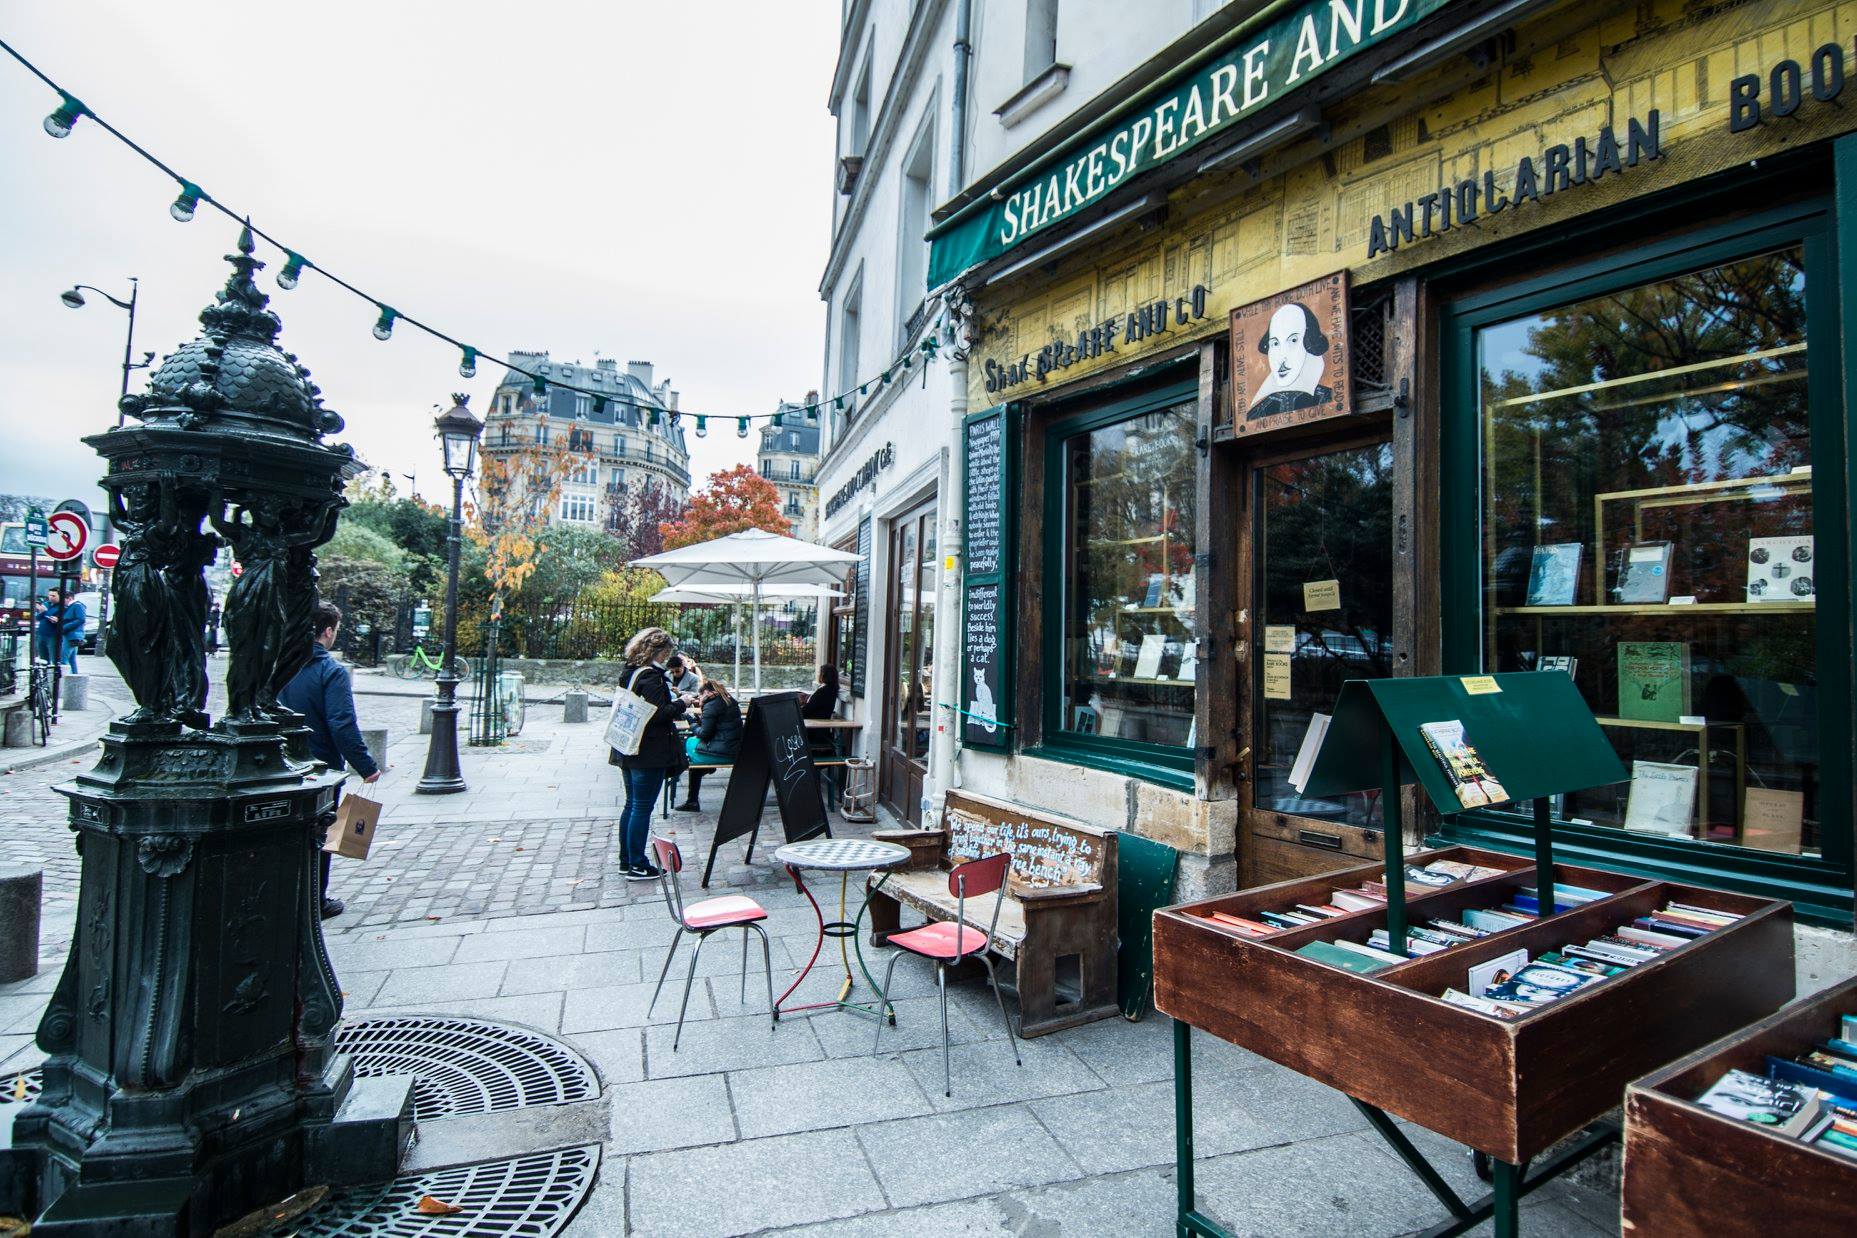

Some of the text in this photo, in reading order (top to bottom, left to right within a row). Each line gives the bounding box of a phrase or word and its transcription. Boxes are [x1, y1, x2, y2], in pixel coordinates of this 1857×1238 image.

[1730, 36, 1857, 134] BOO
[1000, 0, 1408, 247] SHAKESPEARE AND
[1124, 299, 1169, 346] AND
[973, 599, 997, 613] worldly
[967, 621, 997, 633] Beside him
[978, 634, 984, 644] a
[970, 654, 975, 663] a
[1052, 827, 1078, 854] trying
[1080, 839, 1092, 855] to
